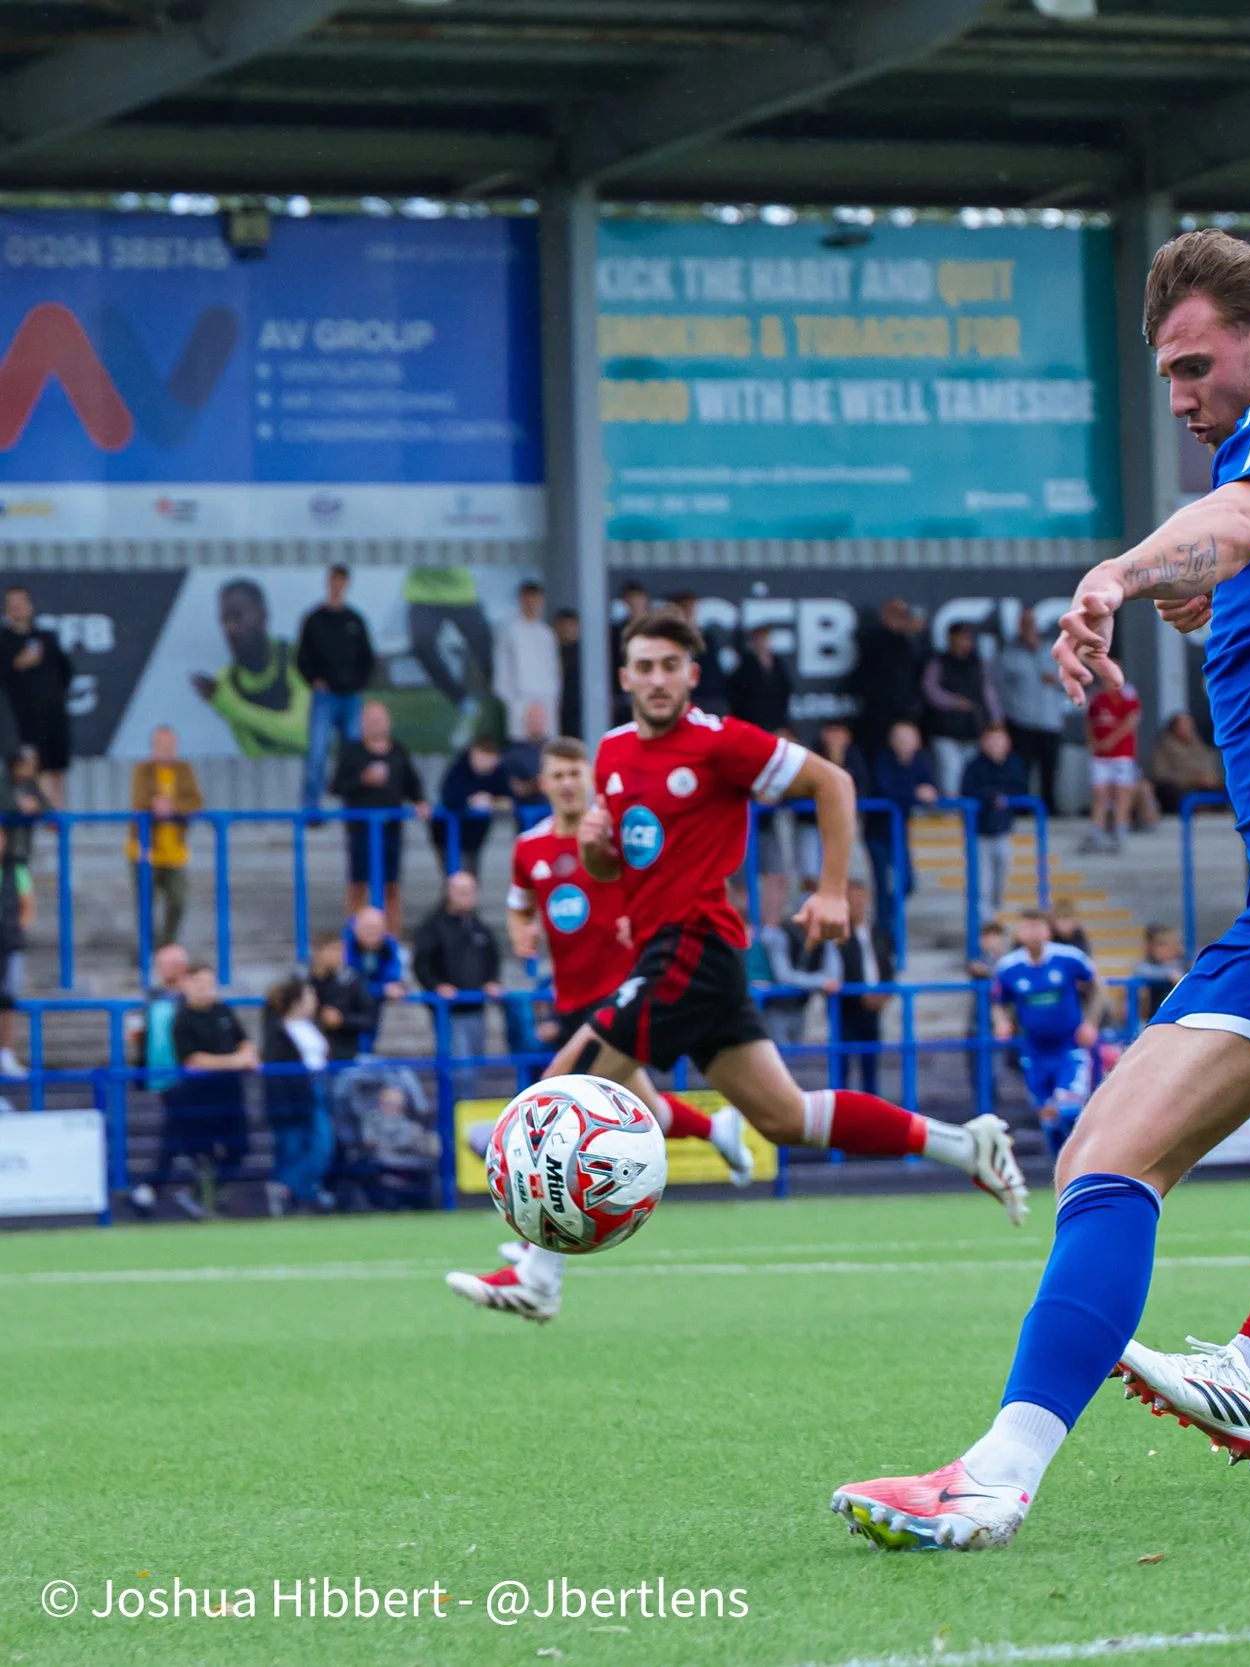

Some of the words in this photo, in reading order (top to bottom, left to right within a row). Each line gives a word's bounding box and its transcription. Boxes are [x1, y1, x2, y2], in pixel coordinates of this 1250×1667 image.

[597, 256, 673, 301] KICK
[681, 256, 743, 300] THE
[751, 257, 852, 301] HABIT
[861, 257, 935, 301] AND
[938, 259, 1014, 309] QUIT
[312, 318, 435, 353] GROUP
[794, 315, 951, 358] TOBACCO
[957, 315, 1022, 358] FOR
[695, 379, 786, 424] WITH
[791, 379, 833, 424] BE
[838, 379, 932, 424] WELL
[935, 379, 1095, 424] TAMESIDE
[545, 1154, 567, 1214] Mitre
